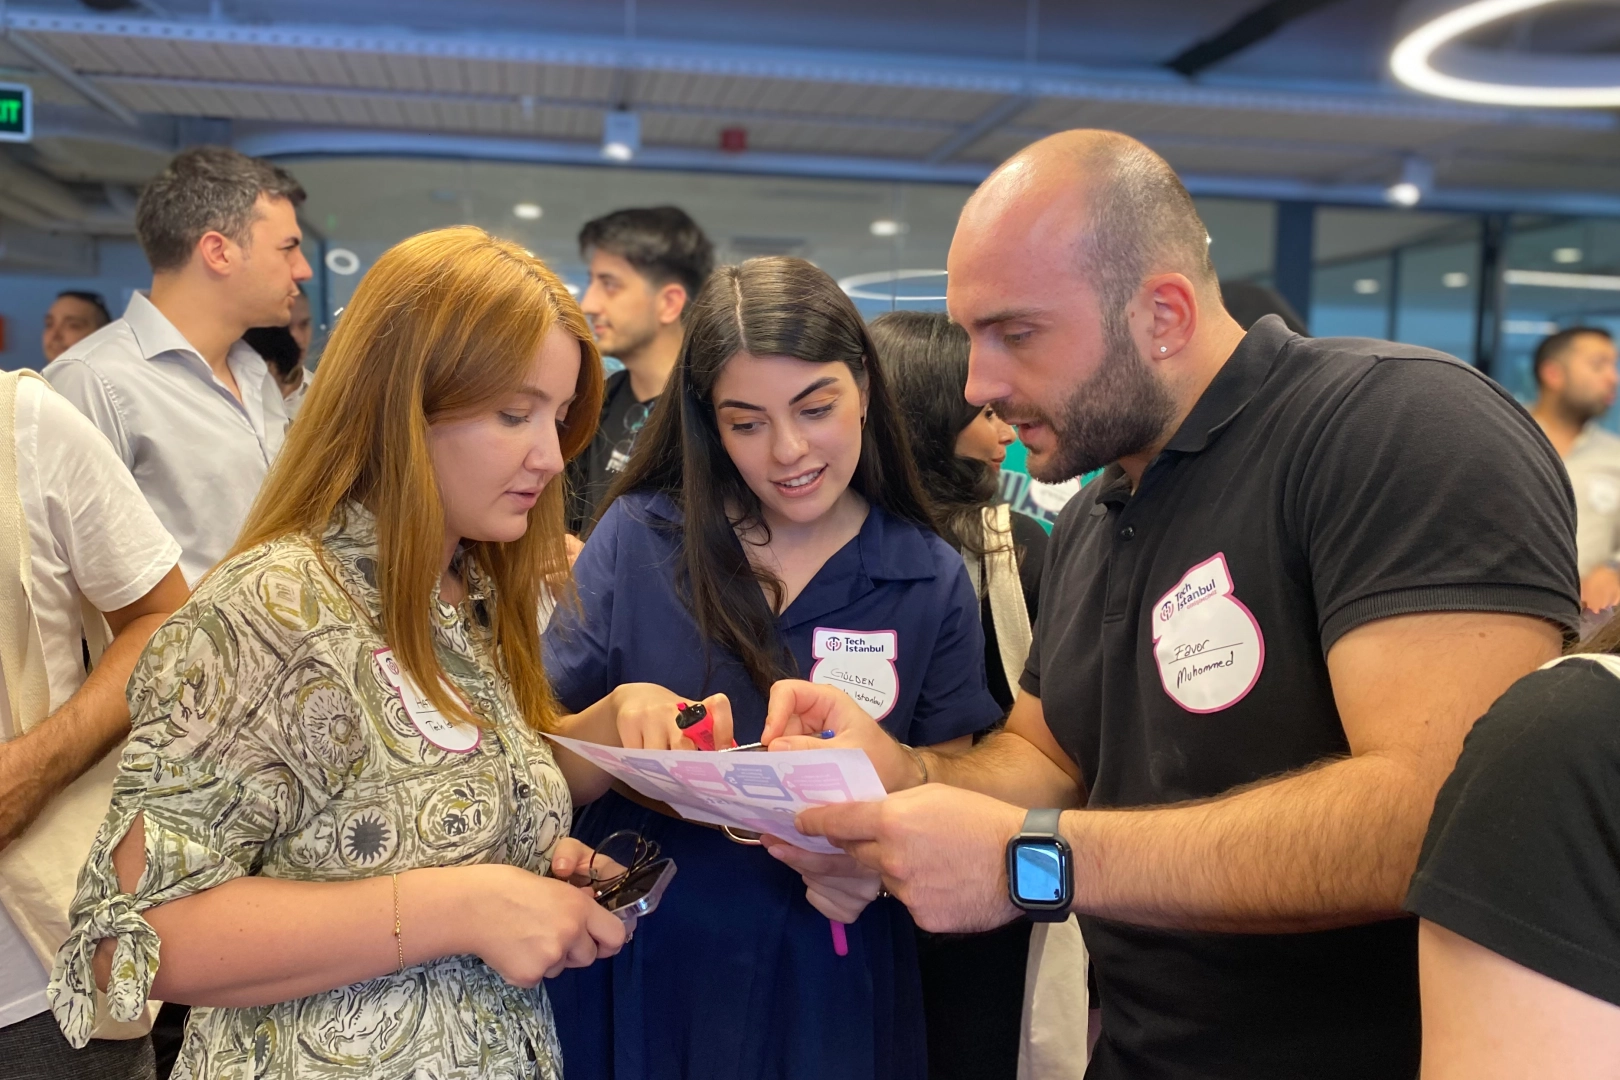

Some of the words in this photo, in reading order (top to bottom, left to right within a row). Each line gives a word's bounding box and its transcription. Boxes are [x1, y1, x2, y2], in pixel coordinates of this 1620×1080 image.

[0, 99, 21, 123] IT
[1175, 583, 1192, 602] Tech
[1177, 579, 1216, 611] Istanbul
[844, 637, 866, 645] Tech
[845, 645, 884, 653] Istanbul
[830, 668, 875, 687] GÜLDEN
